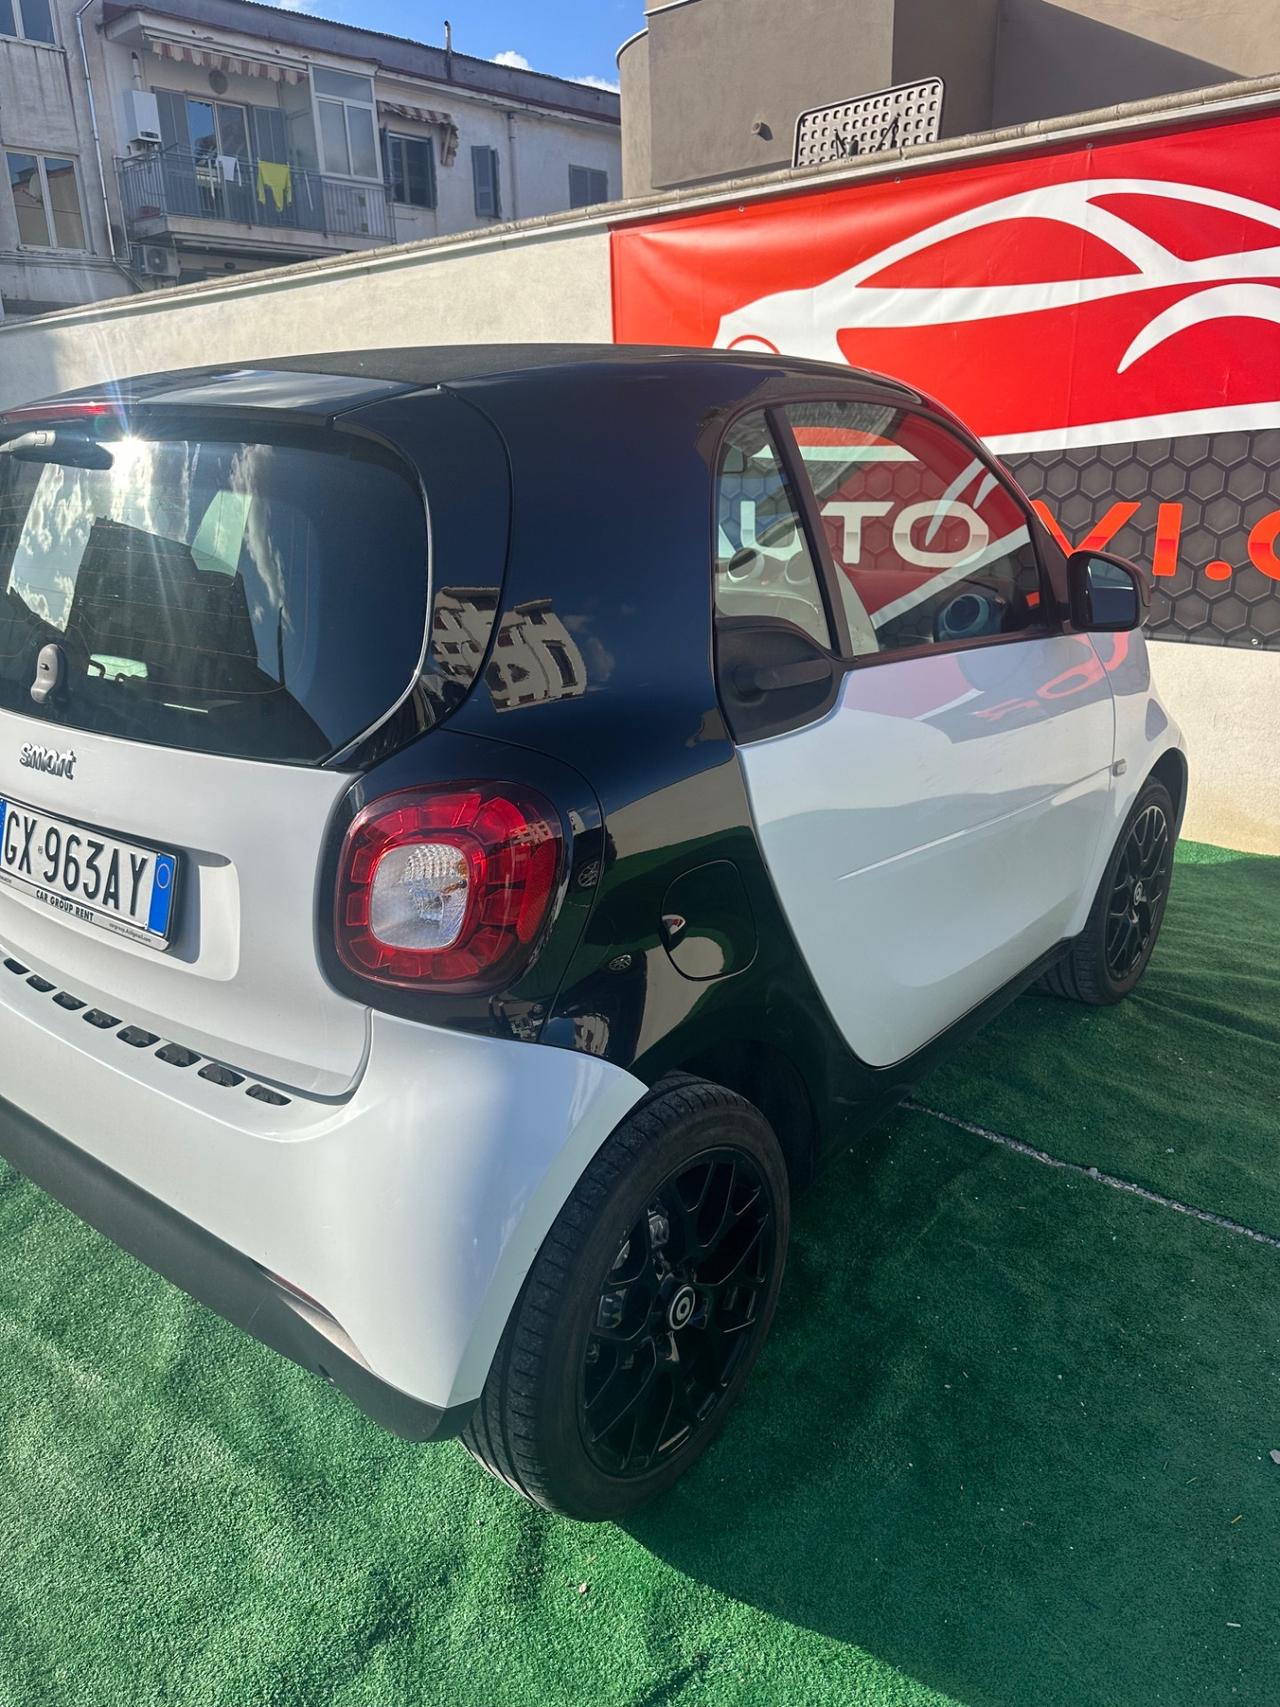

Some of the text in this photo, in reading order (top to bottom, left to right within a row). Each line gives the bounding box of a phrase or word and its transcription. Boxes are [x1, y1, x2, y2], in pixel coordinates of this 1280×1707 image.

[19, 742, 76, 780] smart
[36, 889, 95, 922] CAR GROUP RENT
